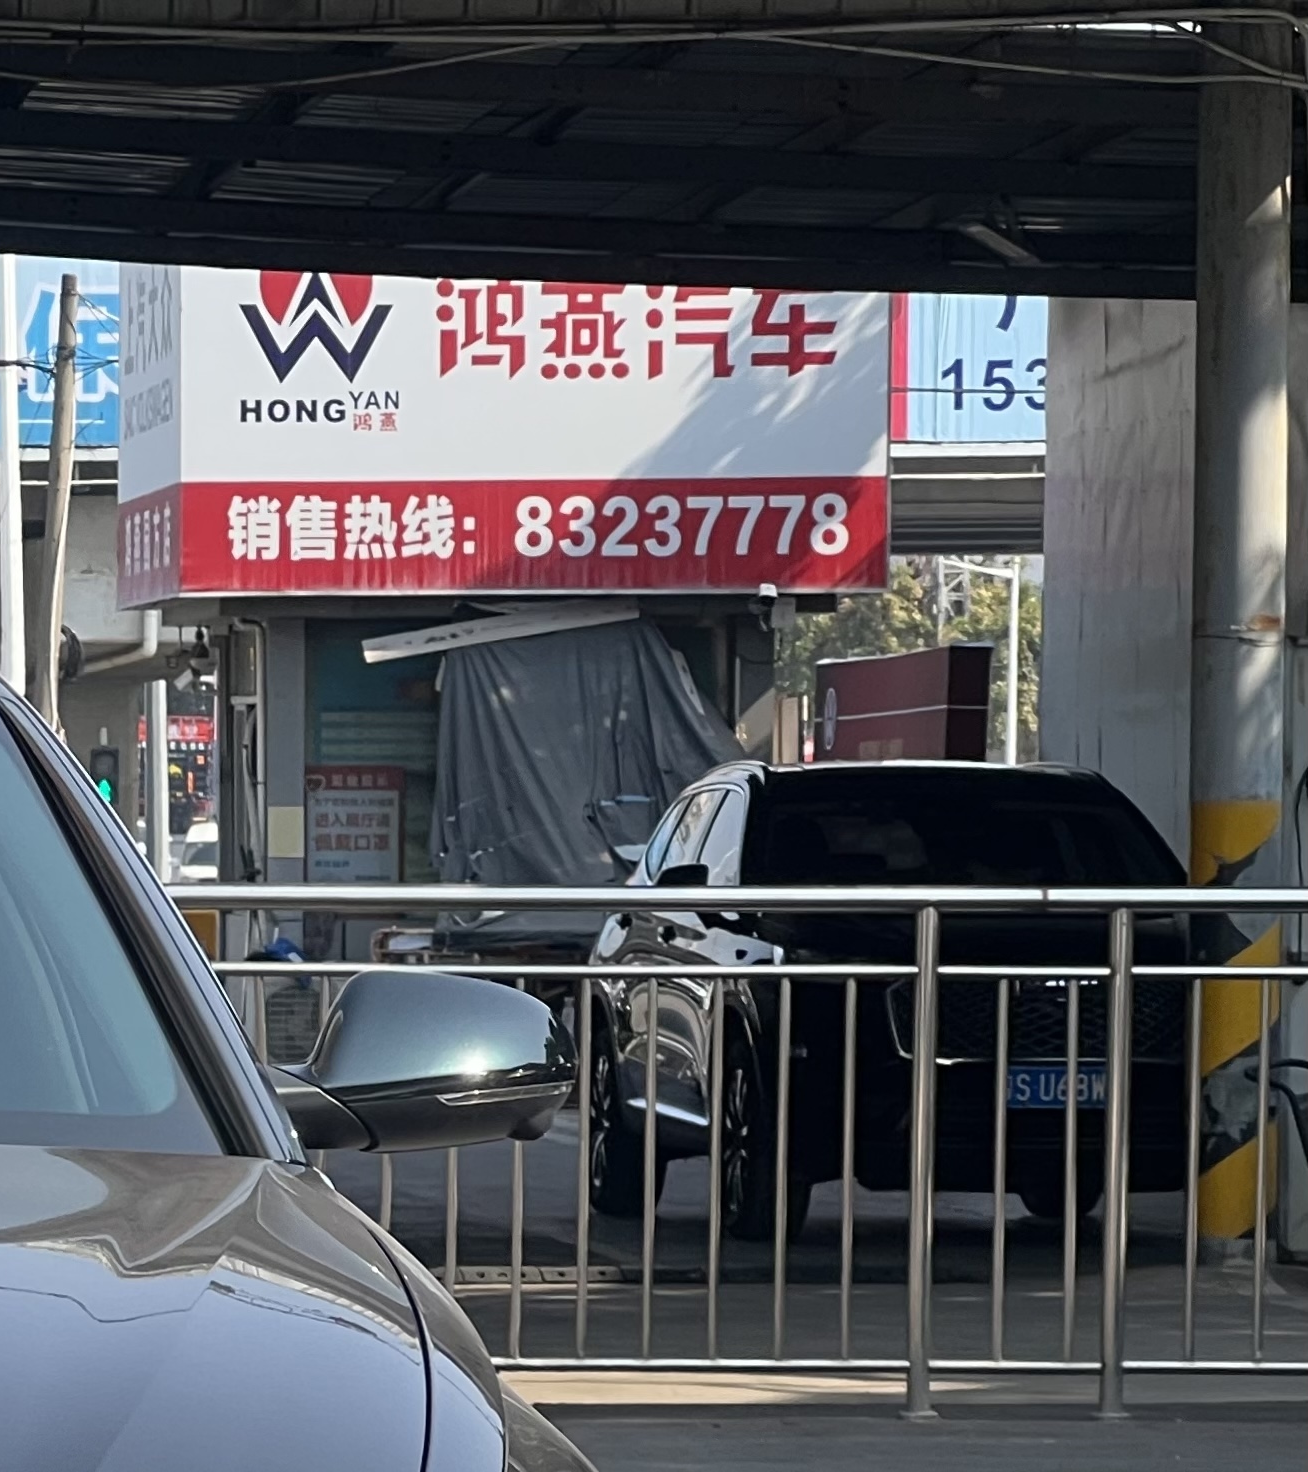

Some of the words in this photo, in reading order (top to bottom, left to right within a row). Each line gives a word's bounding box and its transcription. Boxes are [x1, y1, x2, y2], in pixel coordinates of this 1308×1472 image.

[436, 279, 837, 380] 鸿燕汽车
[240, 400, 346, 422] HONG
[349, 390, 399, 410] YAN
[941, 358, 1046, 411] 153
[514, 494, 850, 556] 83237778
